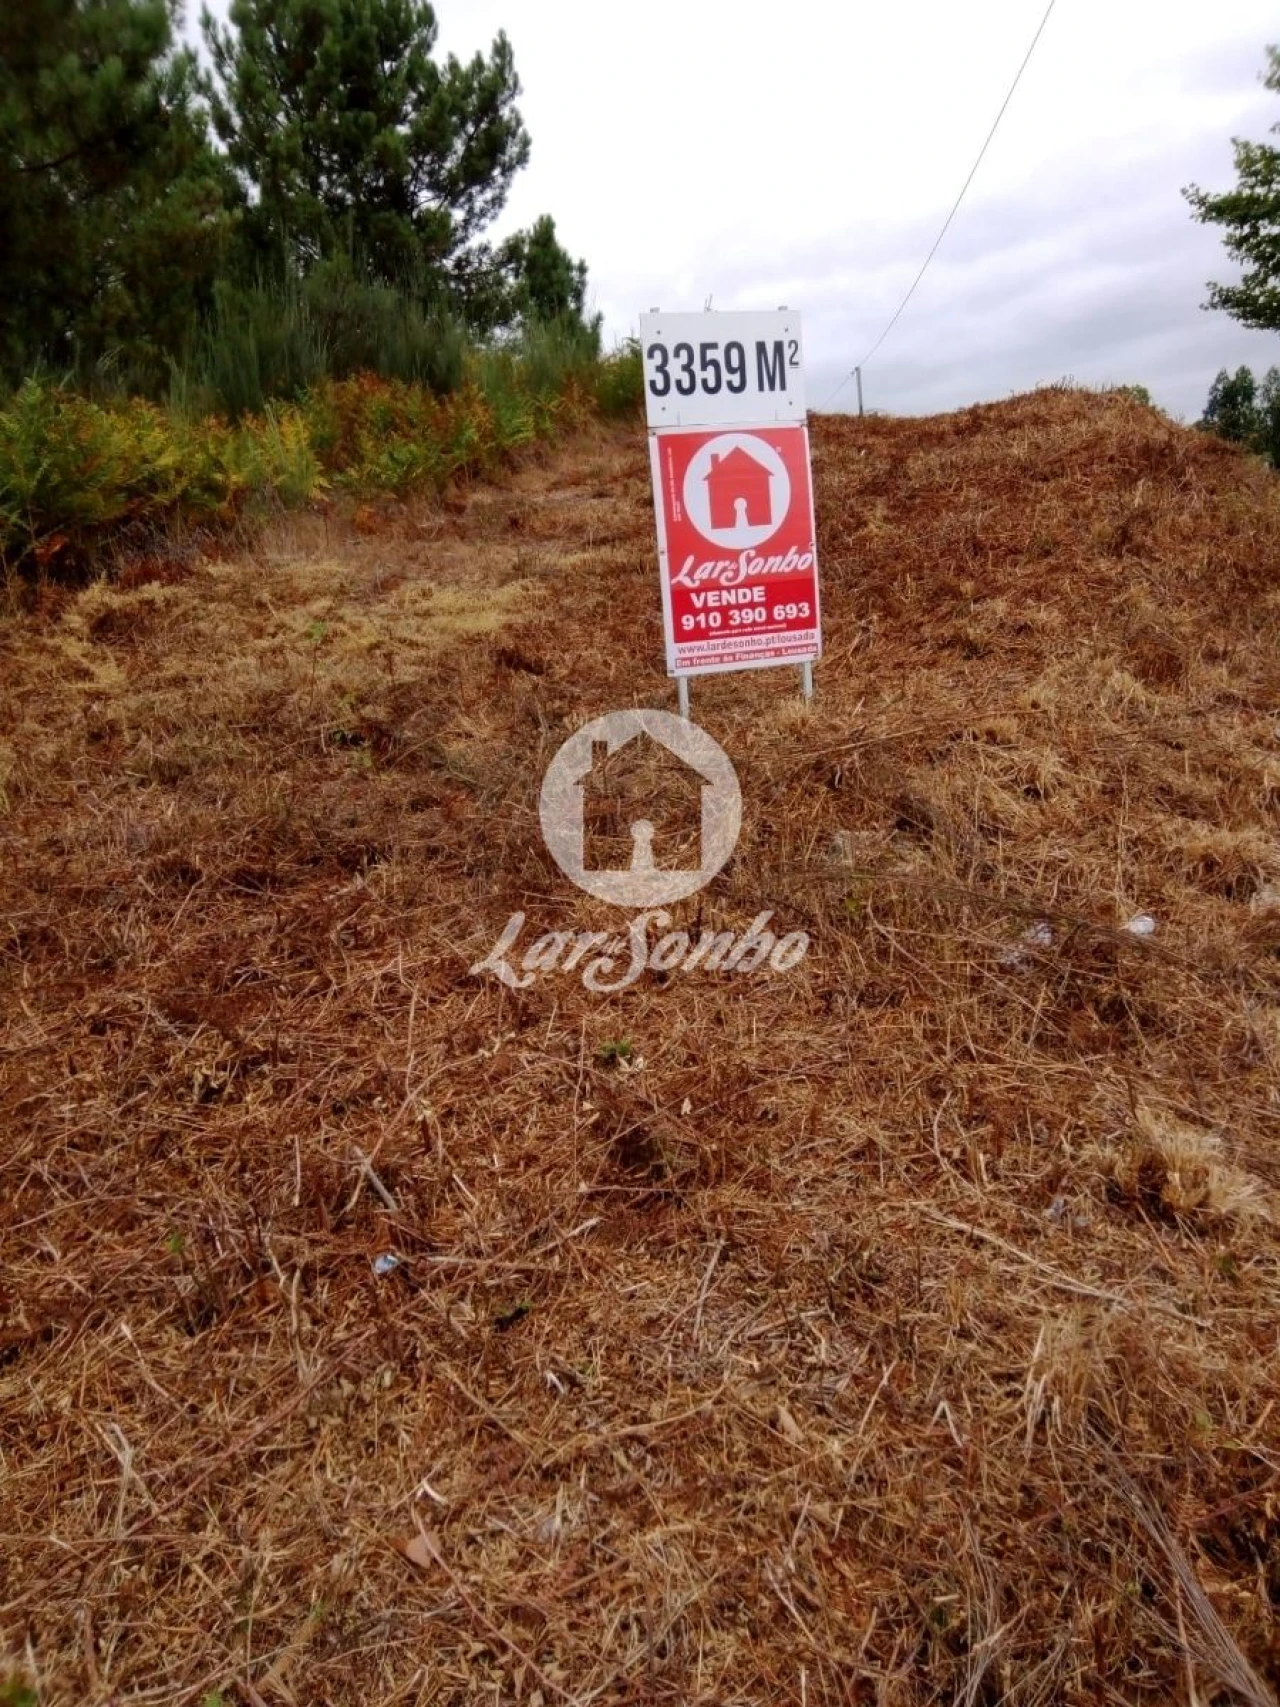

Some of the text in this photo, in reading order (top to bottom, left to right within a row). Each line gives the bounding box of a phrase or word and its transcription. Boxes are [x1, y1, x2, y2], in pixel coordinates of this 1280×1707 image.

[647, 341, 747, 397] 3359
[690, 586, 766, 608] VENDE
[681, 612, 721, 631] 910
[728, 607, 767, 626] 390
[773, 602, 811, 620] 693
